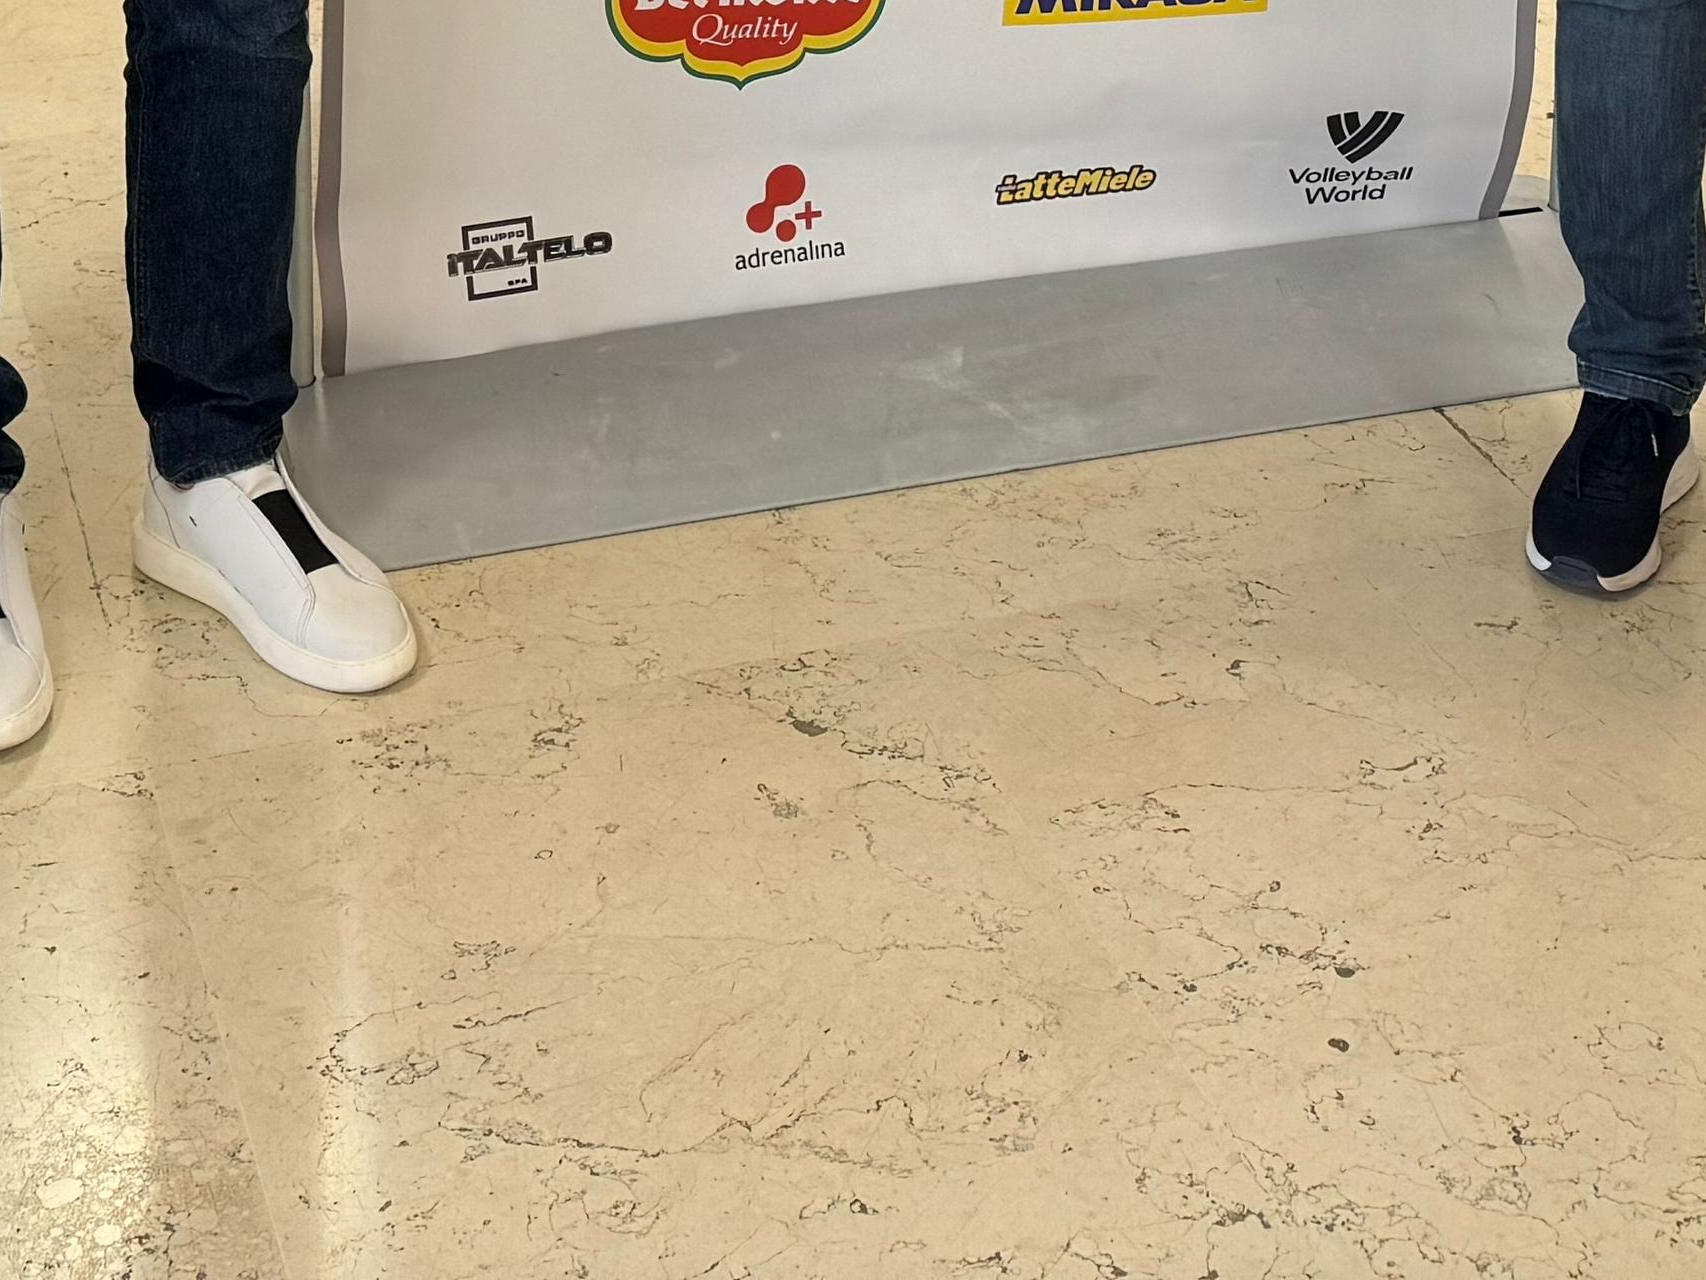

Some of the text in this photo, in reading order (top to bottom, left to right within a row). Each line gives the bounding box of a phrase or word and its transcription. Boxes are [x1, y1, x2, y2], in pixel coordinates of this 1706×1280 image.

[691, 13, 798, 46] Quality
[995, 164, 1157, 206] LatteMiele
[1288, 166, 1414, 186] Volleyball
[1304, 183, 1387, 205] World
[471, 229, 526, 245] GRUPPO
[735, 239, 846, 271] adrenalina
